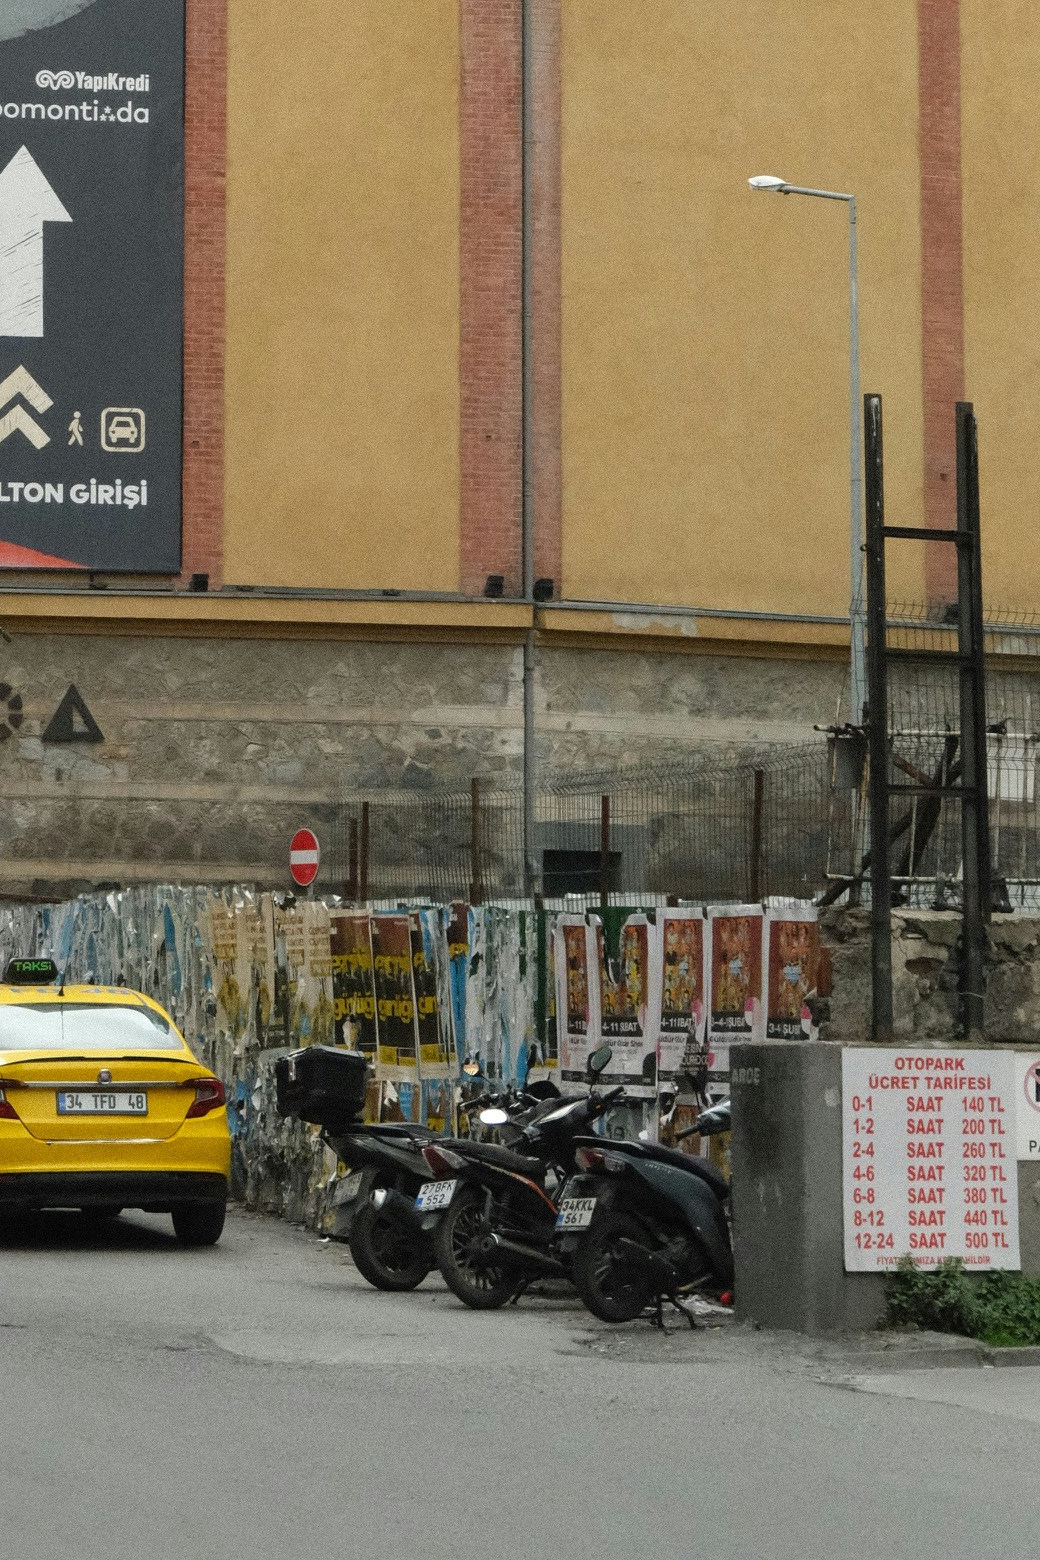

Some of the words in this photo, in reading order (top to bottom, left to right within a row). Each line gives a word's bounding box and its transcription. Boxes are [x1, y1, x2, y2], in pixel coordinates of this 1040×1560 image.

[69, 478, 148, 510] GİRİŞİ
[894, 1057, 965, 1071] OTOPARK
[868, 1073, 920, 1090] ÜCRET
[924, 1074, 991, 1090] TARİFESİ
[66, 1094, 82, 1109] 34
[92, 1094, 116, 1109] TFD
[128, 1094, 144, 1109] 48
[852, 1095, 874, 1112] 0-1
[906, 1095, 944, 1112] SAAT
[961, 1095, 985, 1112] 140
[988, 1095, 1005, 1112] TL
[853, 1118, 875, 1135] 1-2
[906, 1118, 944, 1135] SAAT
[961, 1118, 985, 1135] 200
[988, 1118, 1006, 1135] TL
[852, 1142, 875, 1159] 2-4
[906, 1142, 945, 1159] SAAT
[962, 1142, 986, 1159] 260
[989, 1142, 1006, 1159] TL
[852, 1165, 875, 1182] 4-6
[907, 1165, 945, 1182] SAAT
[963, 1165, 987, 1182] 320
[990, 1165, 1007, 1182] TL
[426, 1194, 445, 1206] 552
[853, 1187, 875, 1204] 6-8
[907, 1187, 945, 1204] SAAT
[963, 1187, 987, 1204] 380
[990, 1187, 1008, 1204] TL
[564, 1213, 583, 1225] 561
[854, 1209, 885, 1227] 8-12
[908, 1209, 946, 1227] SAAT
[964, 1209, 988, 1227] 440
[991, 1209, 1008, 1227] TL
[854, 1232, 895, 1250] 12-24
[909, 1232, 947, 1250] SAAT
[965, 1232, 989, 1250] 500
[992, 1232, 1009, 1250] TL
